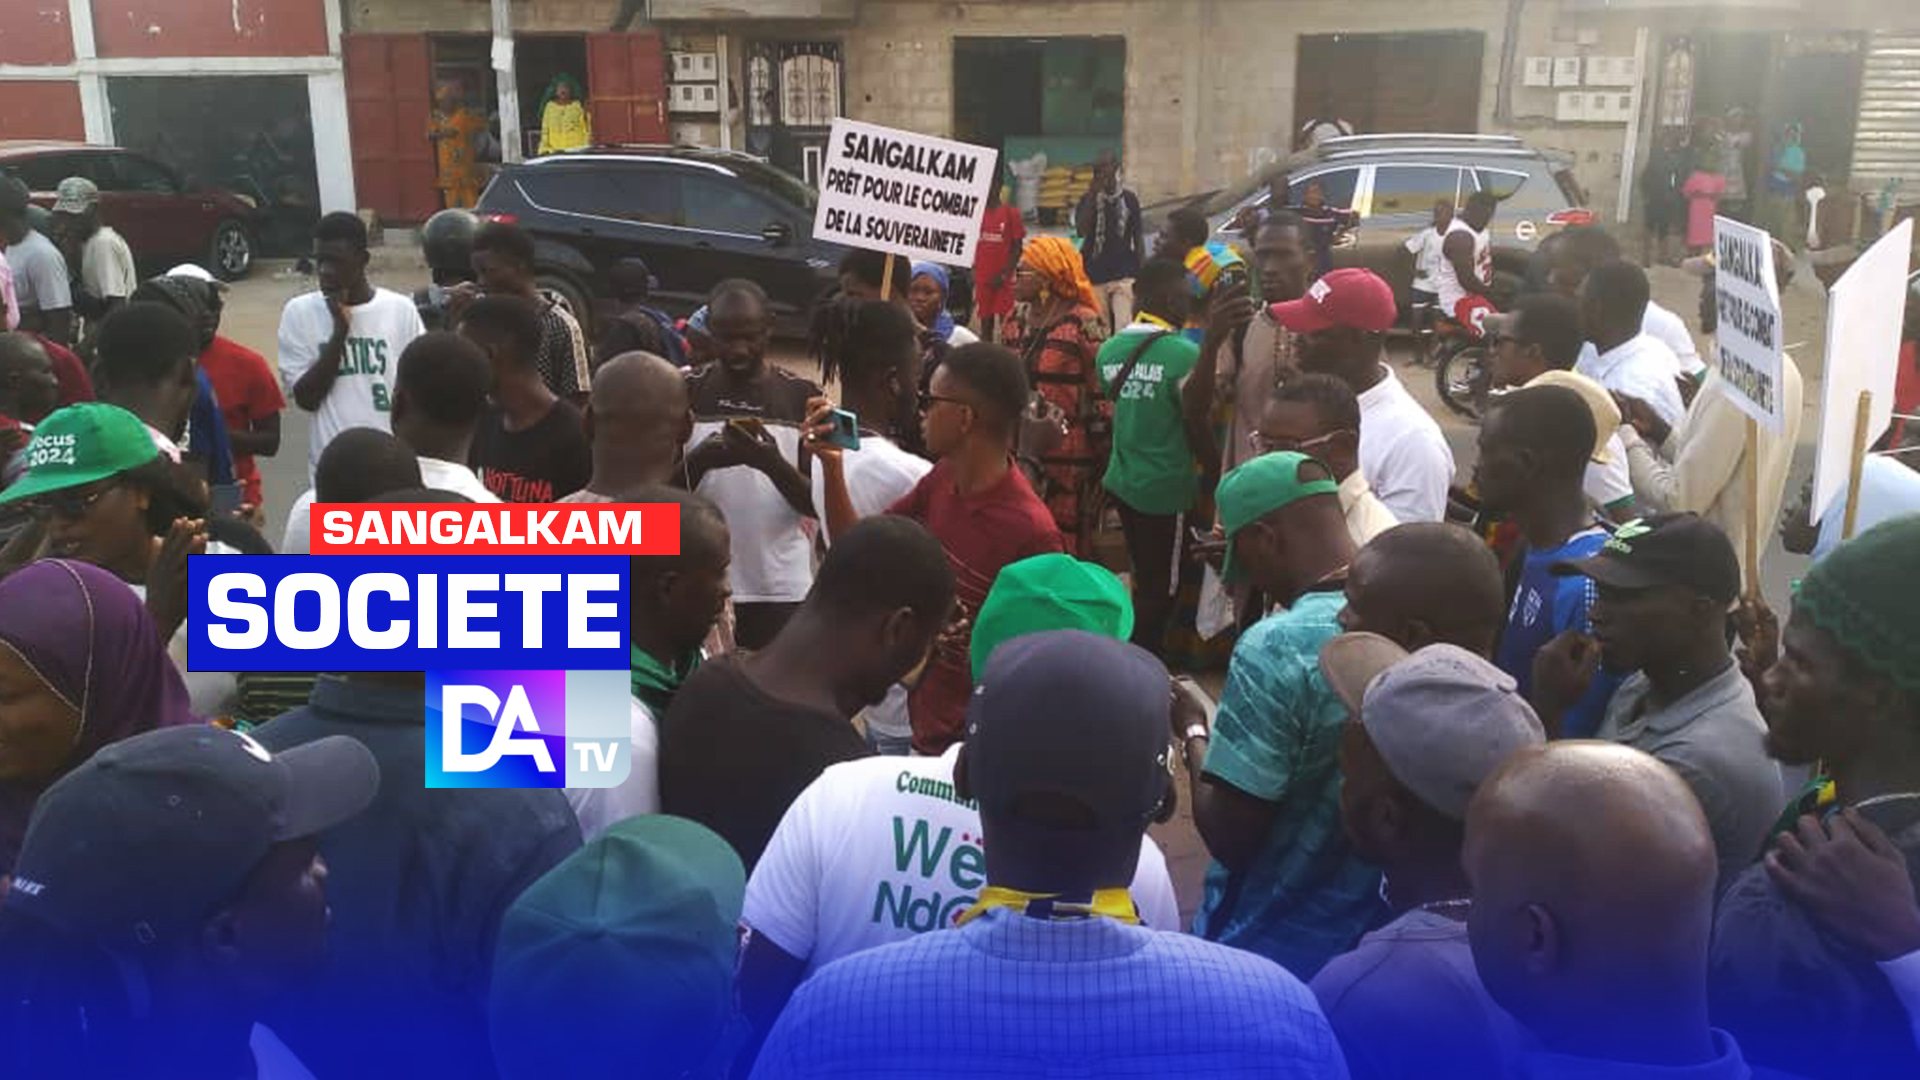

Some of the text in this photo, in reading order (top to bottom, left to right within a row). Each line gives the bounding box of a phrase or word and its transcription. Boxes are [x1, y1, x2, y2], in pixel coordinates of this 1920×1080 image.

[842, 132, 977, 183] SANGALKAM
[863, 175, 901, 205] POUR
[904, 184, 920, 209] LE
[921, 187, 978, 219] COMBAT
[825, 208, 845, 232] DE
[846, 211, 862, 236] LA
[1120, 380, 1155, 399] 024
